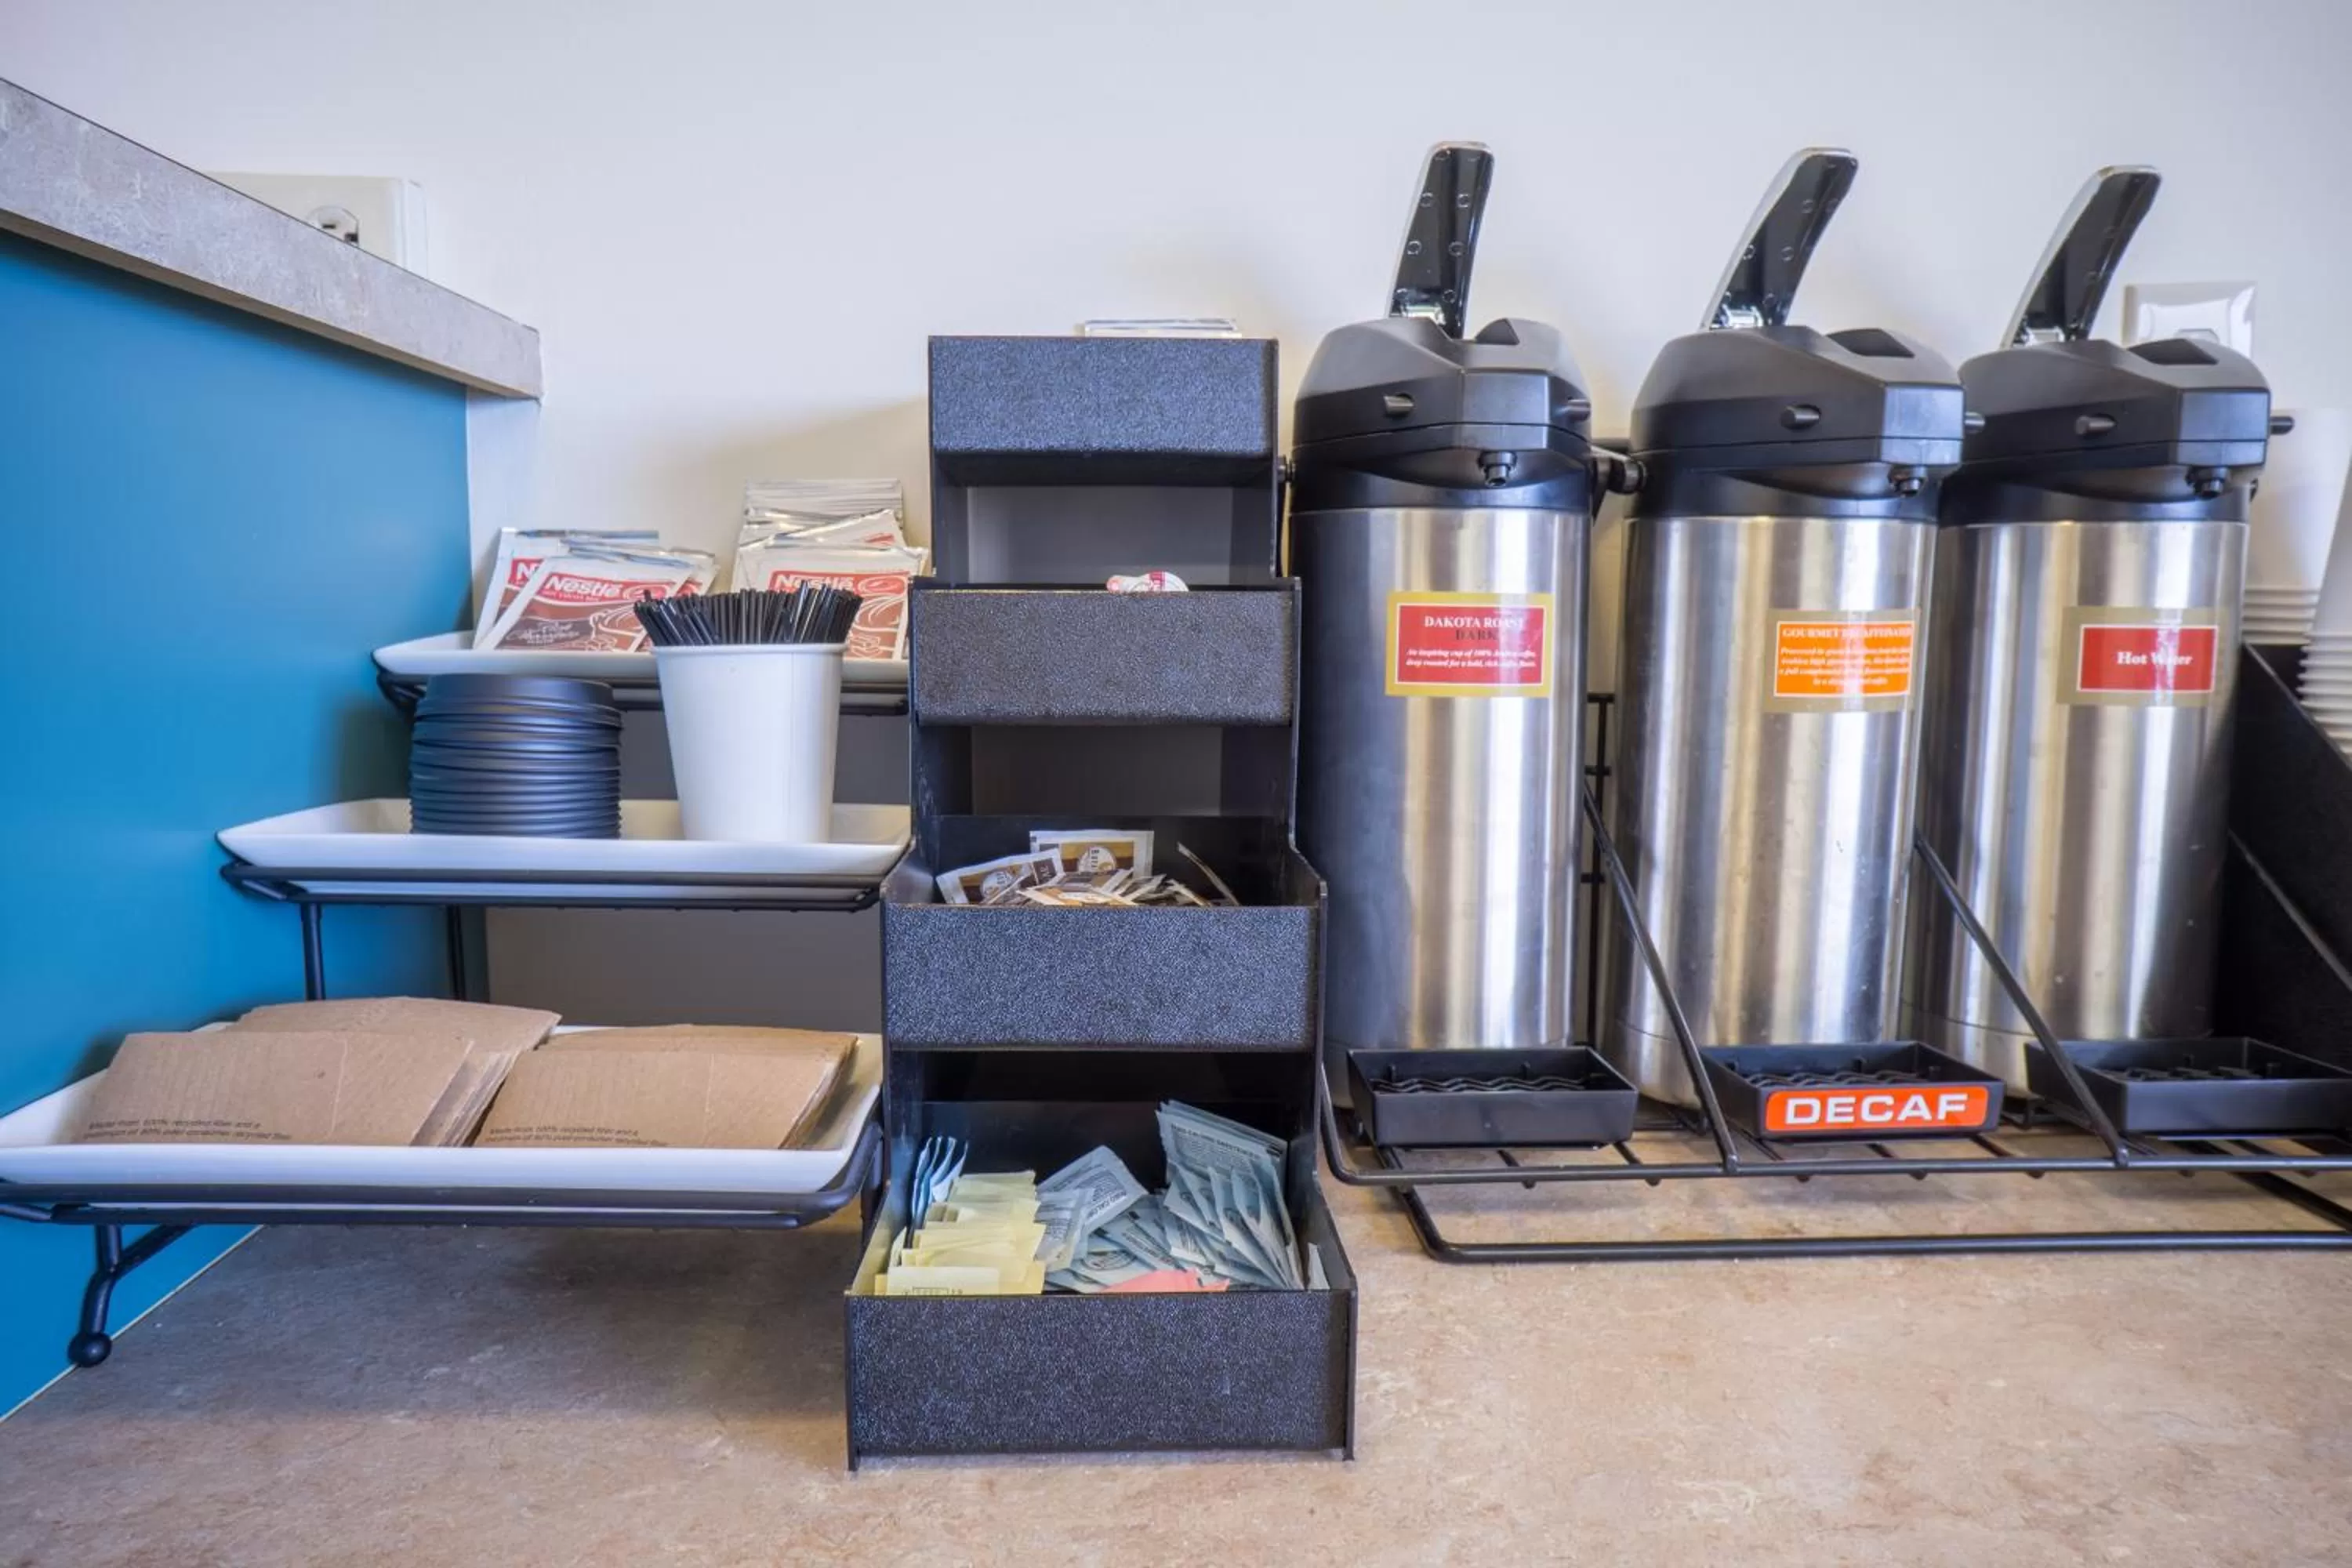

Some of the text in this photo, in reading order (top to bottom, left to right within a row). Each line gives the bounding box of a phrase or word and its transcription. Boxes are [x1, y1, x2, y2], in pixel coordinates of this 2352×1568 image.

[1425, 615, 1480, 628] DAKOTA
[2117, 651, 2148, 666] Hot
[1784, 1093, 1969, 1125] DECAF
